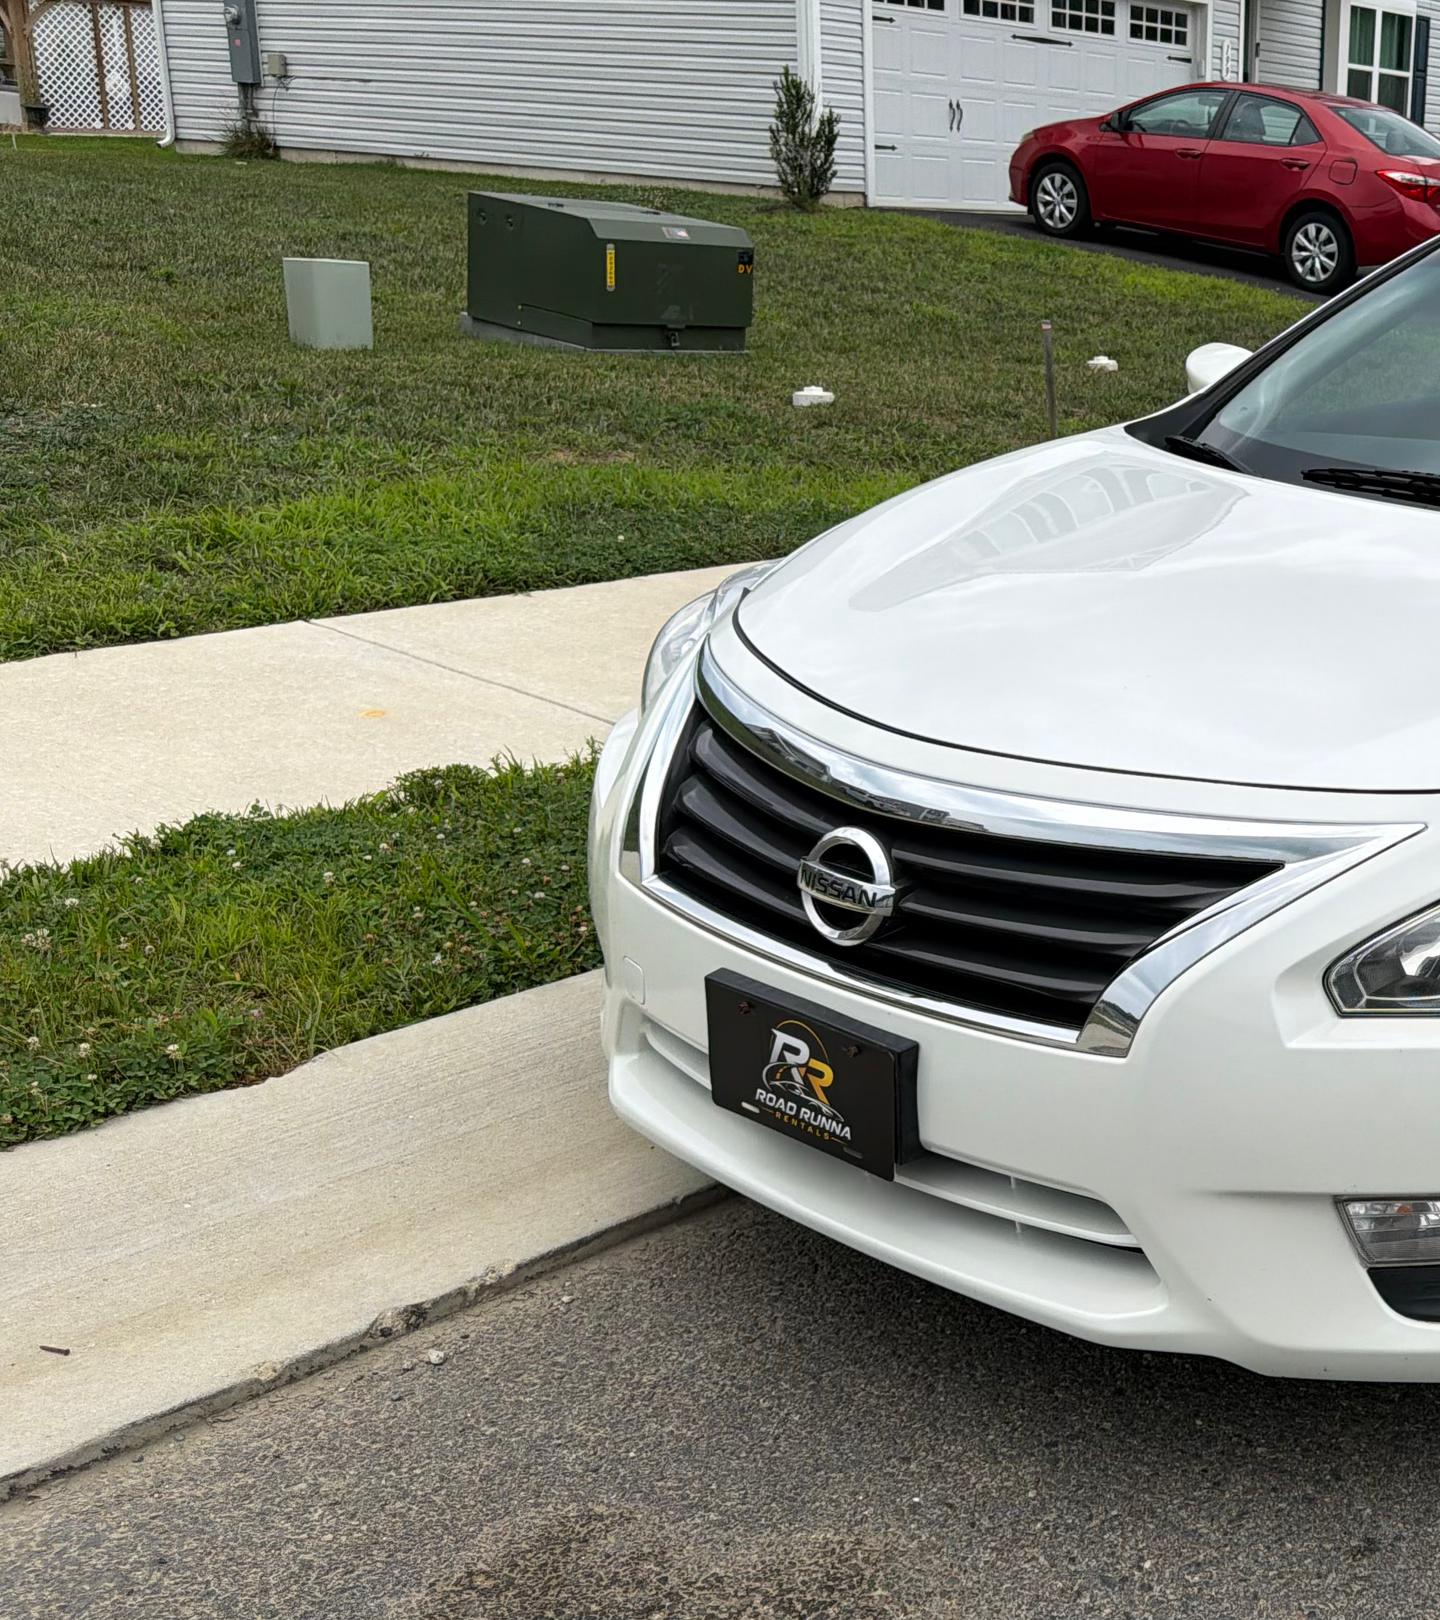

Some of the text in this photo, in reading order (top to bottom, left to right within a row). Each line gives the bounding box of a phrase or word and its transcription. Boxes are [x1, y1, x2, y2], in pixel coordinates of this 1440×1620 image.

[800, 869, 877, 907] NISSAN
[755, 1088, 852, 1140] ROAD RUNNA
[775, 1111, 830, 1140] RENTALS
